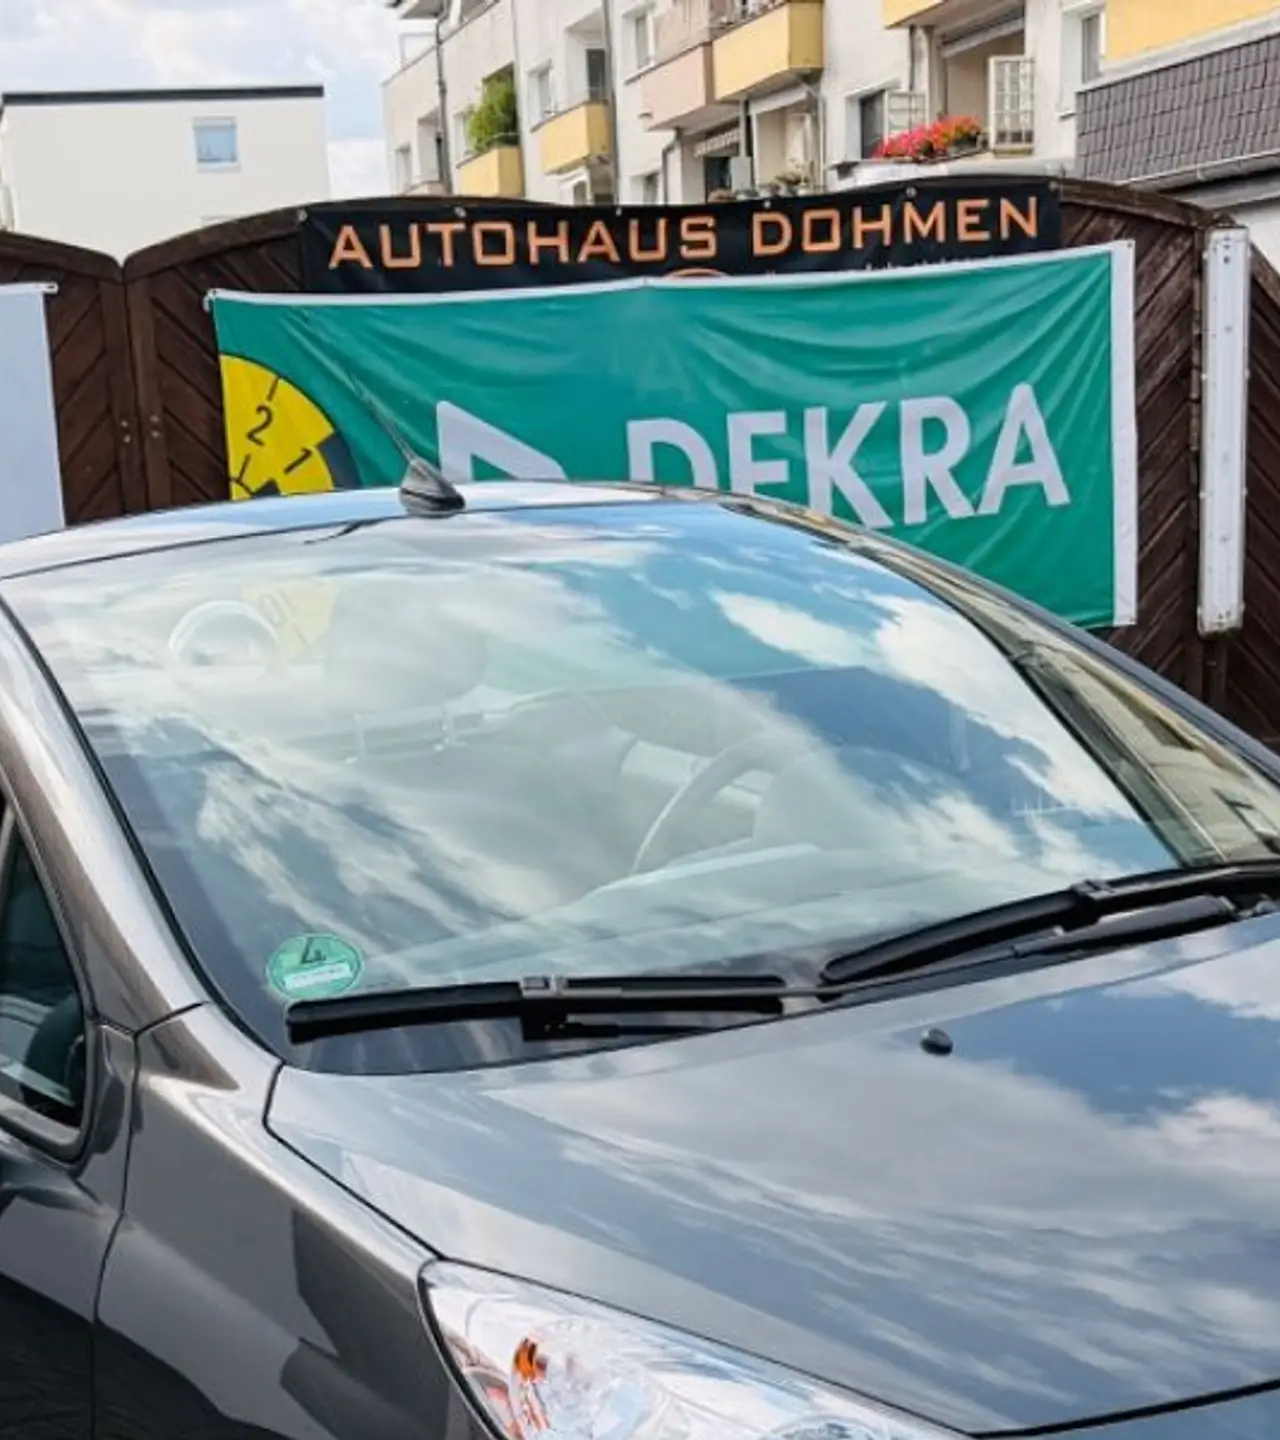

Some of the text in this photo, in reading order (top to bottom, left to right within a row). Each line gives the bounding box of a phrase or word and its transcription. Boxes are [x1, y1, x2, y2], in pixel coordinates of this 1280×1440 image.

[328, 196, 1039, 270] AUTOHAUS DOHMEN
[246, 404, 273, 448] 2
[283, 446, 313, 475] 1
[625, 382, 1071, 530] DEKRA
